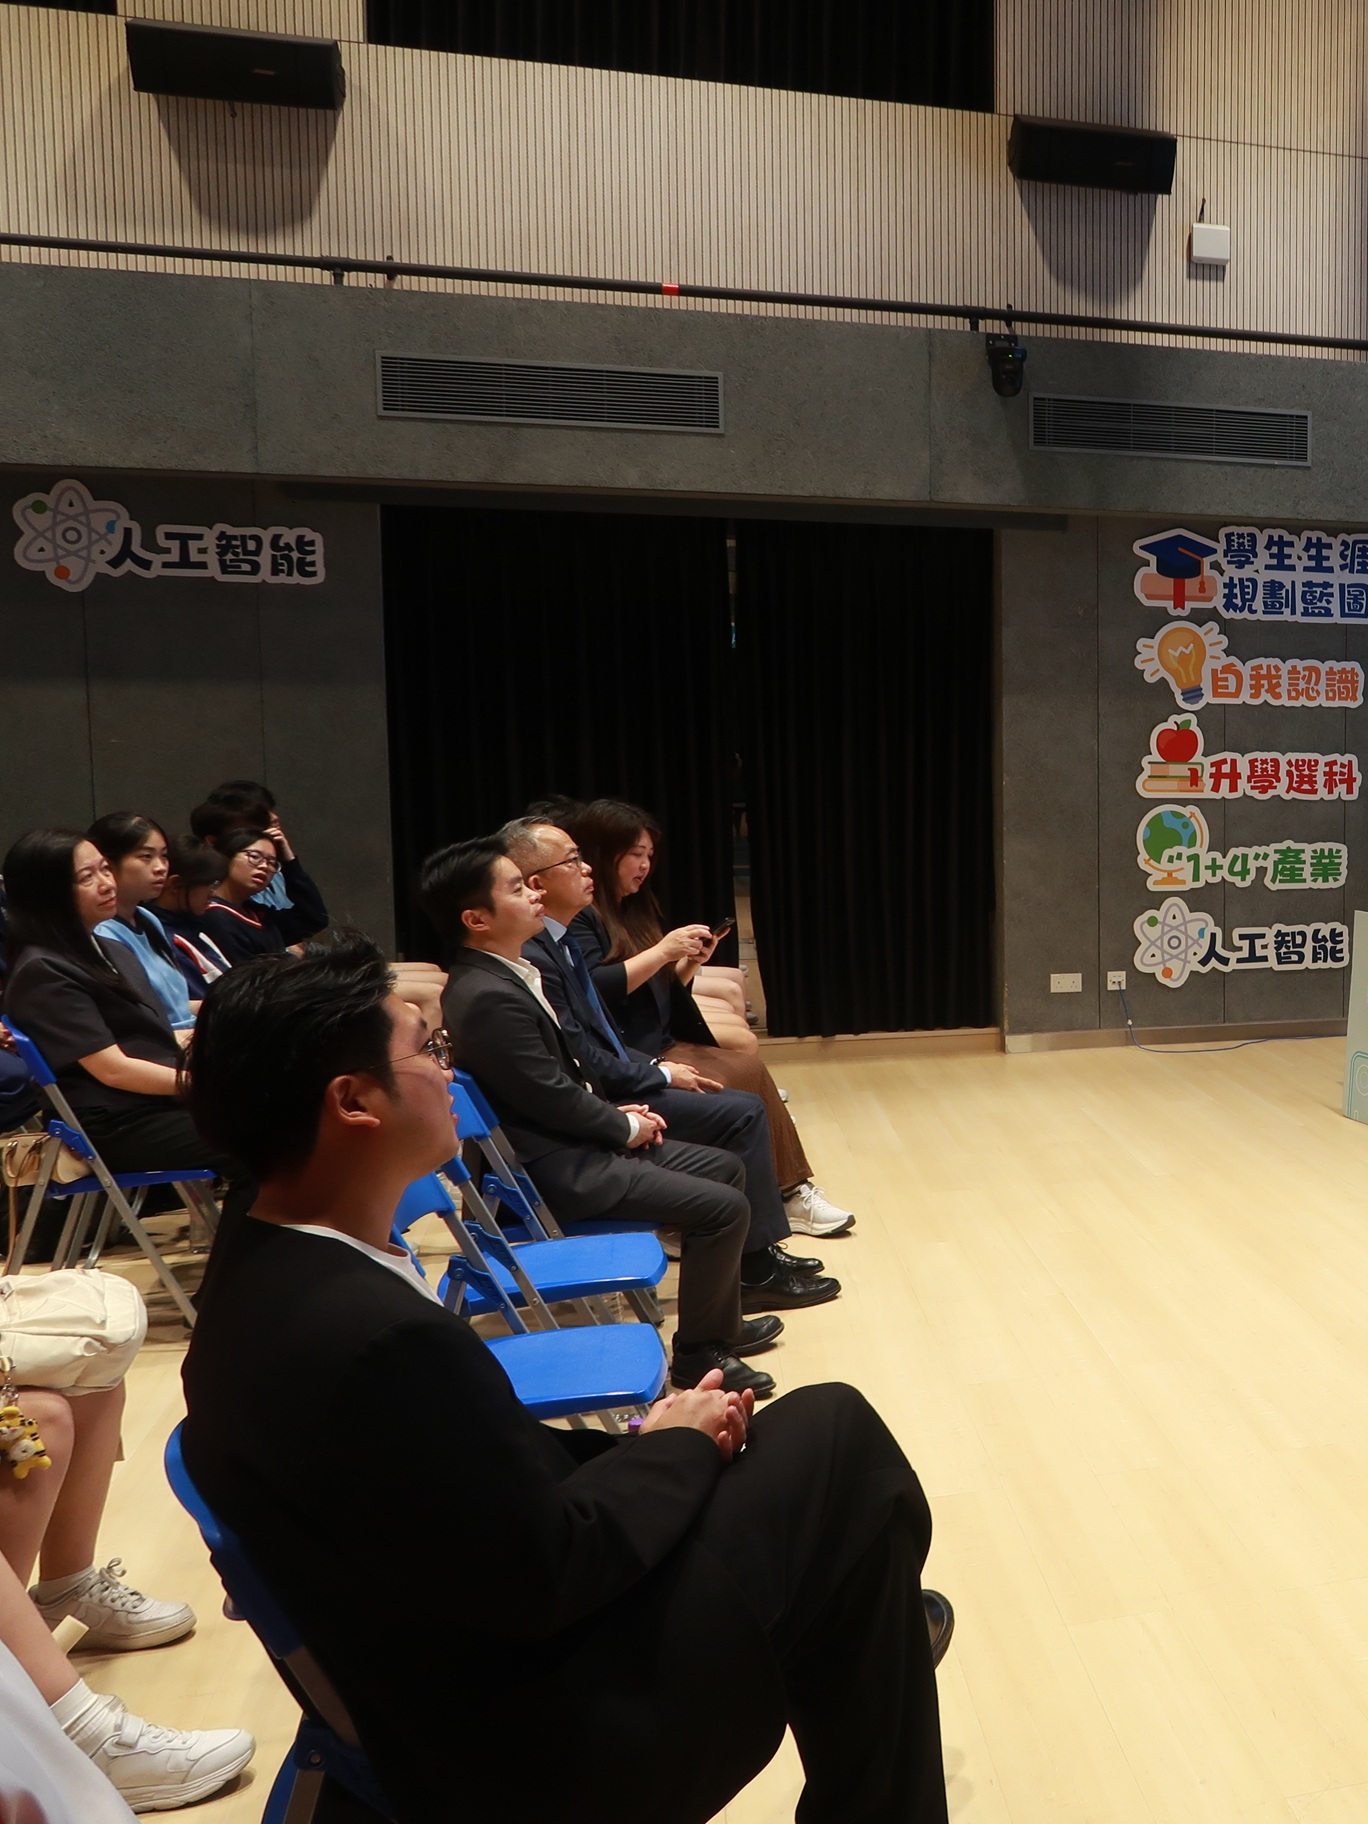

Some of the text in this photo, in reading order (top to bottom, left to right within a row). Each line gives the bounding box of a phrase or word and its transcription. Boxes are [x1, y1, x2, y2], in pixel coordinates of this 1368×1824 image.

[105, 527, 318, 578] 人工智能
[1210, 663, 1359, 703] 自我認識
[1209, 758, 1358, 796] 升學選科
[1197, 930, 1345, 967] 人工智能
